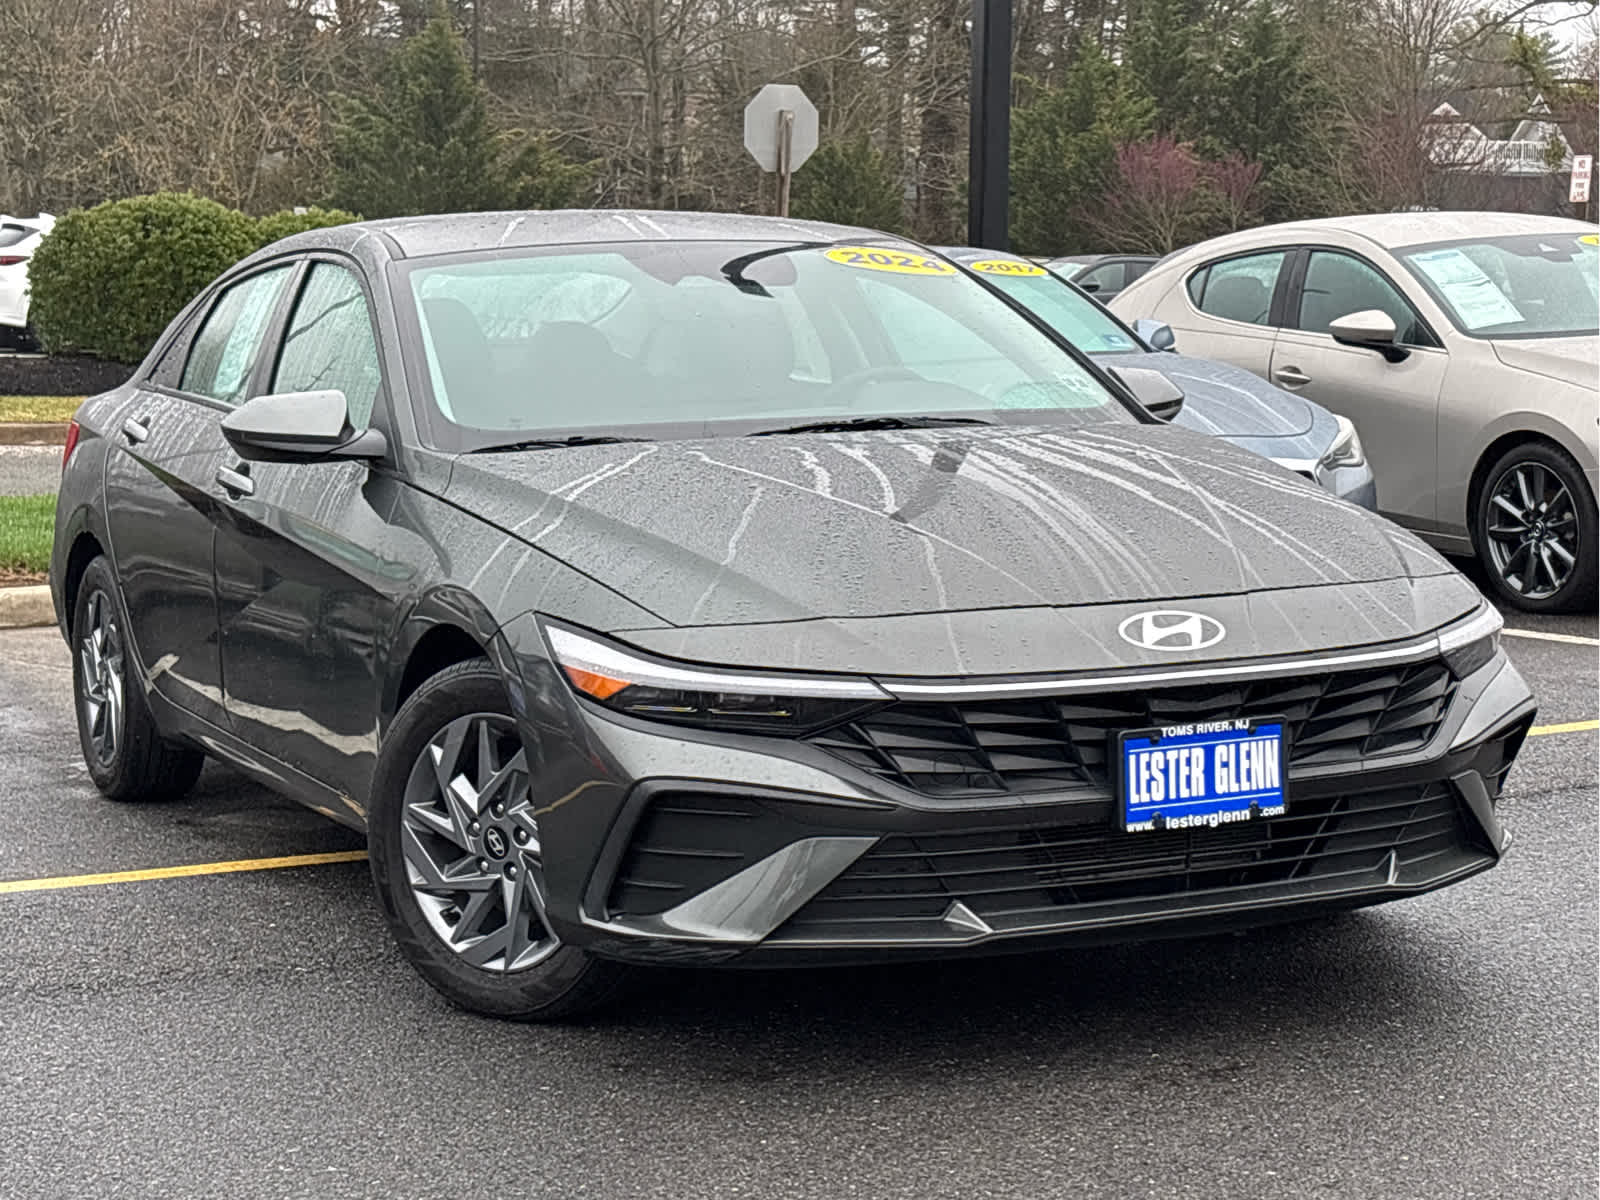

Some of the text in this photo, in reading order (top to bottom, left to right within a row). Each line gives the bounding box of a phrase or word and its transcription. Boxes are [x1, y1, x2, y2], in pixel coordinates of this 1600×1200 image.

[840, 251, 945, 272] 2024
[1160, 725, 1194, 738] TOMS
[1234, 718, 1250, 730] NJ
[1129, 739, 1280, 804] LESTER GLENN
